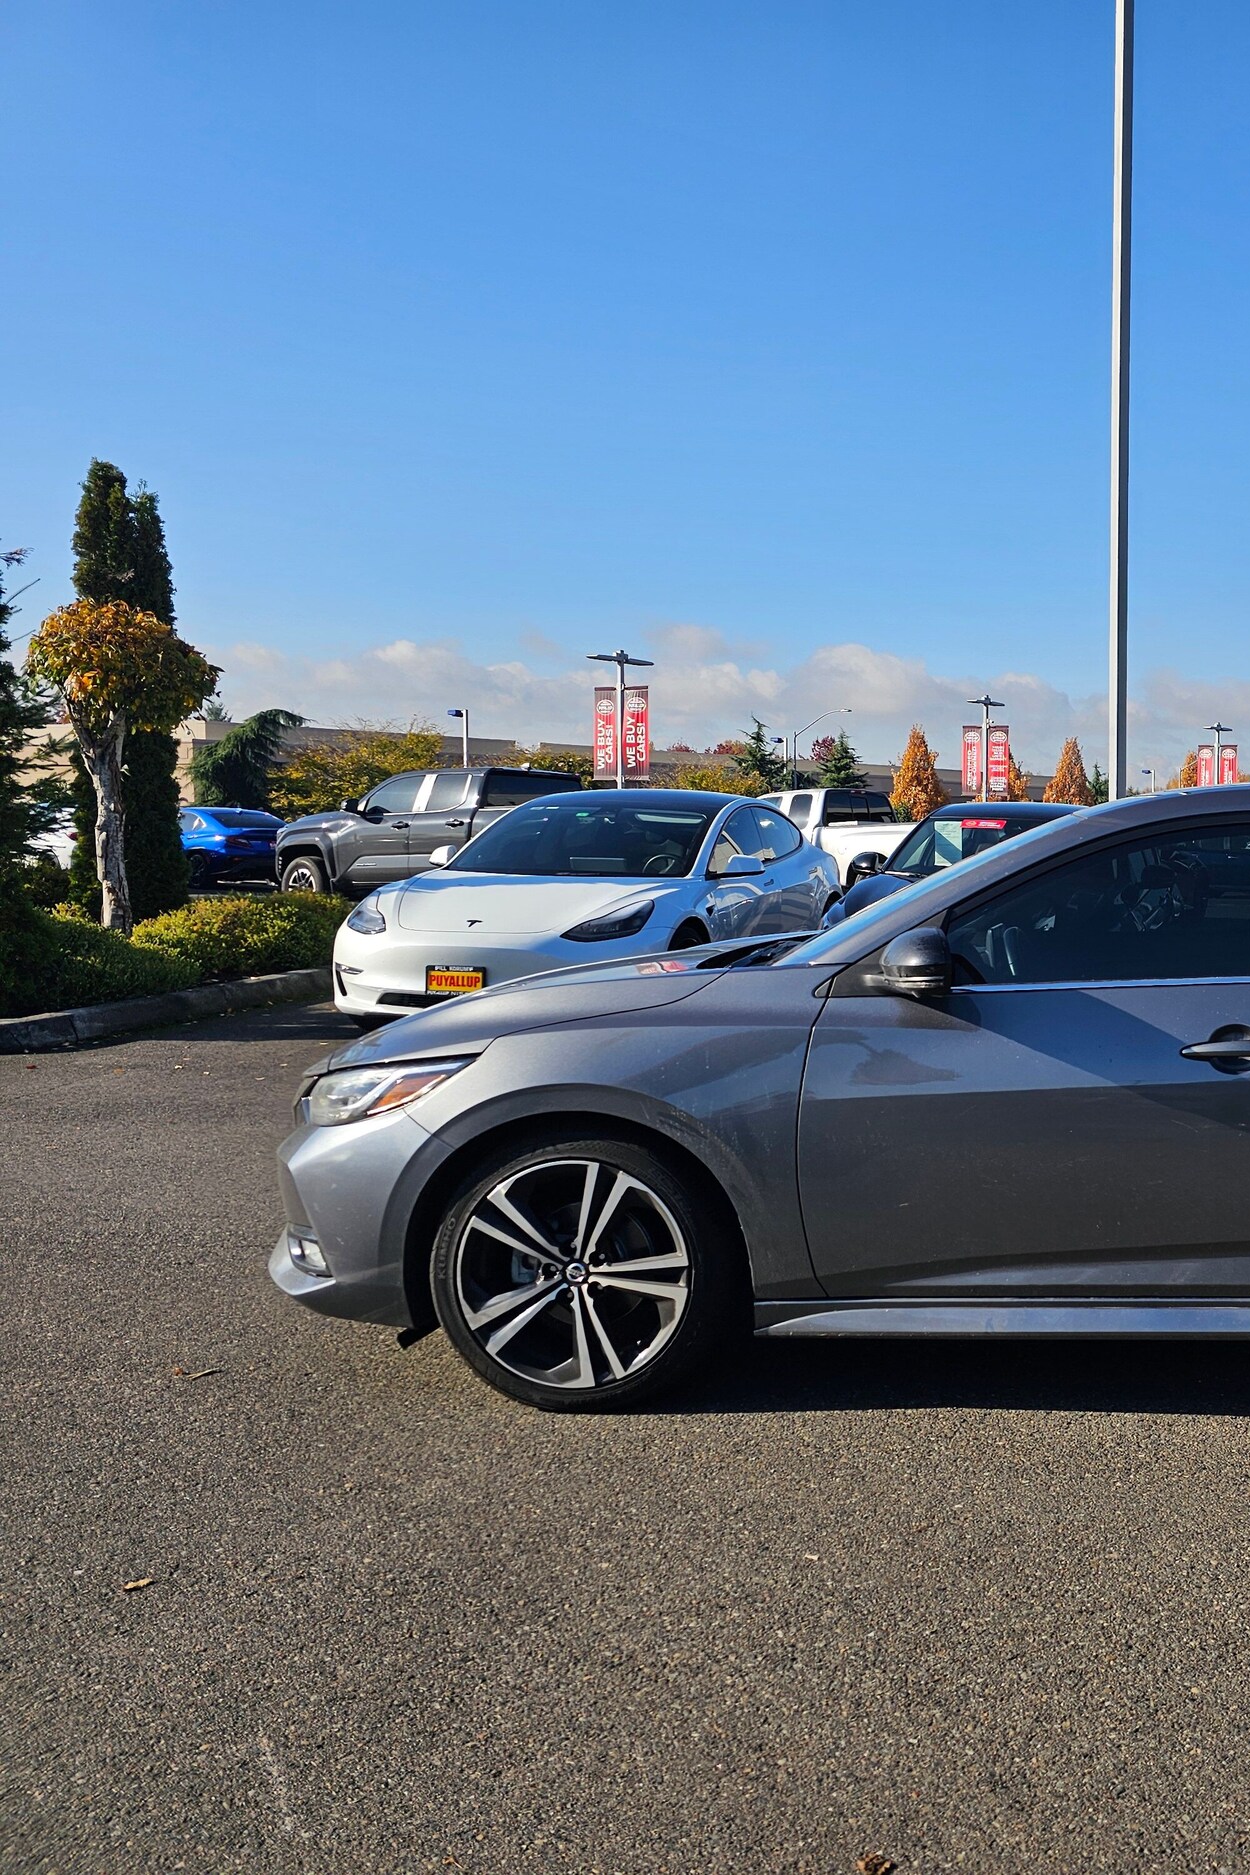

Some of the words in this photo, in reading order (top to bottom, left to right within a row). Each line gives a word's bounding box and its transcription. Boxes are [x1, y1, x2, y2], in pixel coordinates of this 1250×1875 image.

[597, 719, 606, 744] BUY
[626, 717, 636, 743] BUY
[636, 722, 646, 762] CARS!
[605, 724, 614, 764] CARS!
[597, 748, 605, 770] WE
[627, 746, 636, 768] WE
[429, 975, 480, 987] PUYALLUP
[437, 1217, 456, 1280] KUMHO
